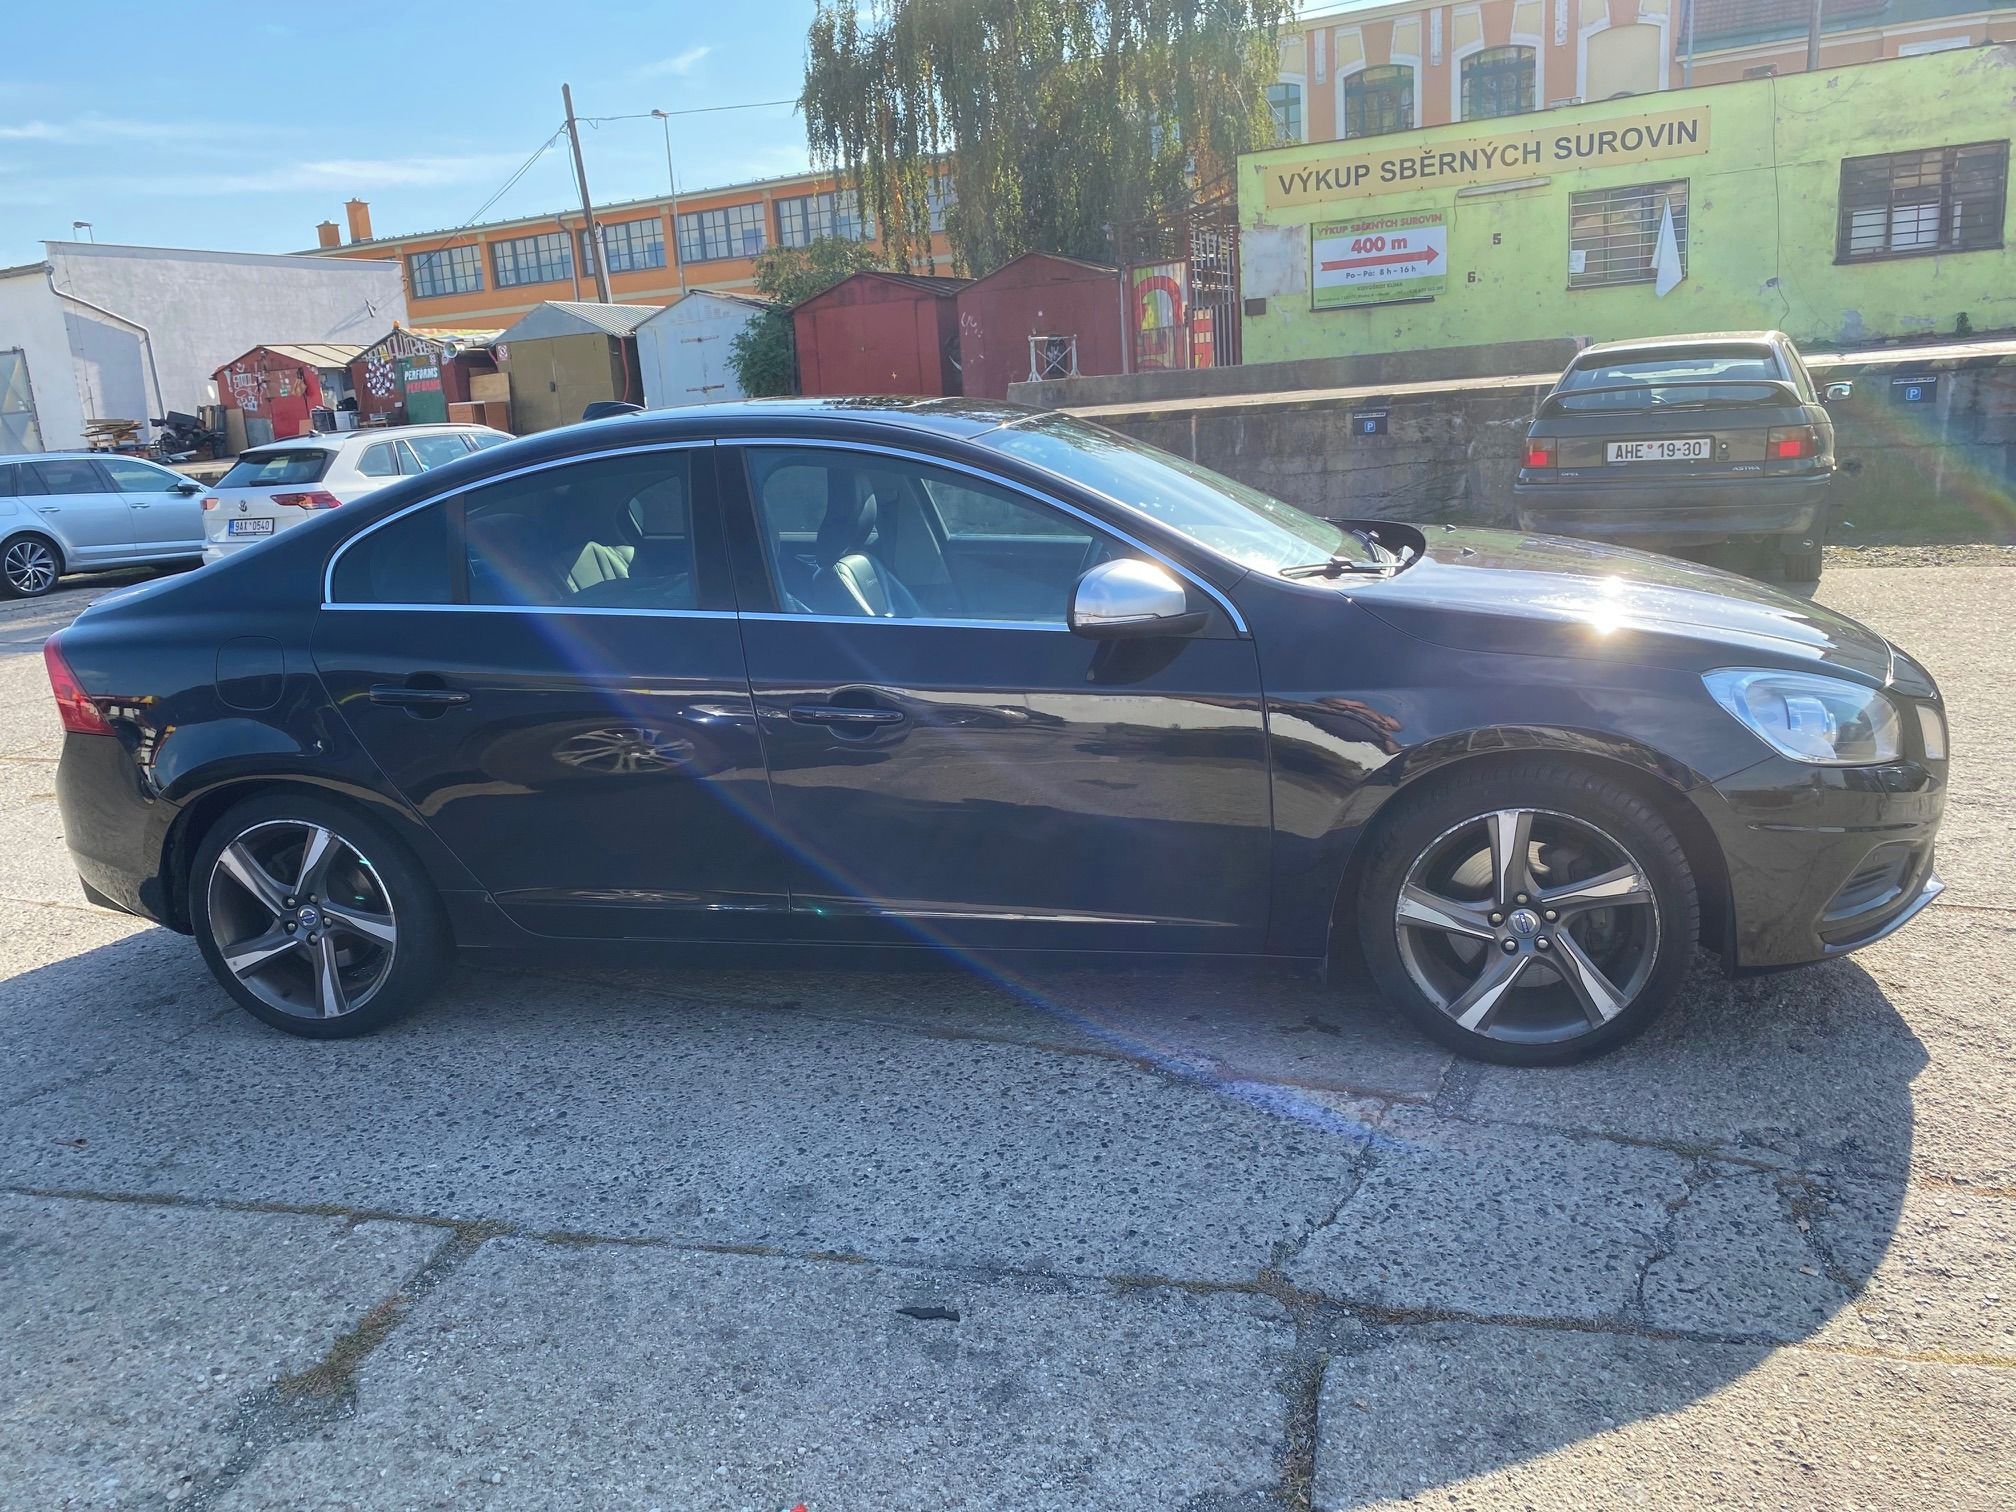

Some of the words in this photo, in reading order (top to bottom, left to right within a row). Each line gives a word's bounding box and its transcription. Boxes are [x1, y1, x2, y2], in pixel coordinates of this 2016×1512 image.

[1278, 166, 1370, 195] VÝKUP
[1380, 141, 1541, 183] SBĚRNÝCH
[1554, 119, 1698, 160] SUROVIN
[1401, 213, 1442, 226] SUROVIN
[1351, 236, 1386, 254] 400
[1391, 237, 1408, 250] m
[1492, 232, 1502, 245] 5
[1467, 271, 1476, 283] 6
[1615, 444, 1644, 459] AHE
[1657, 441, 1701, 458] 19-30
[252, 520, 270, 531] 0540
